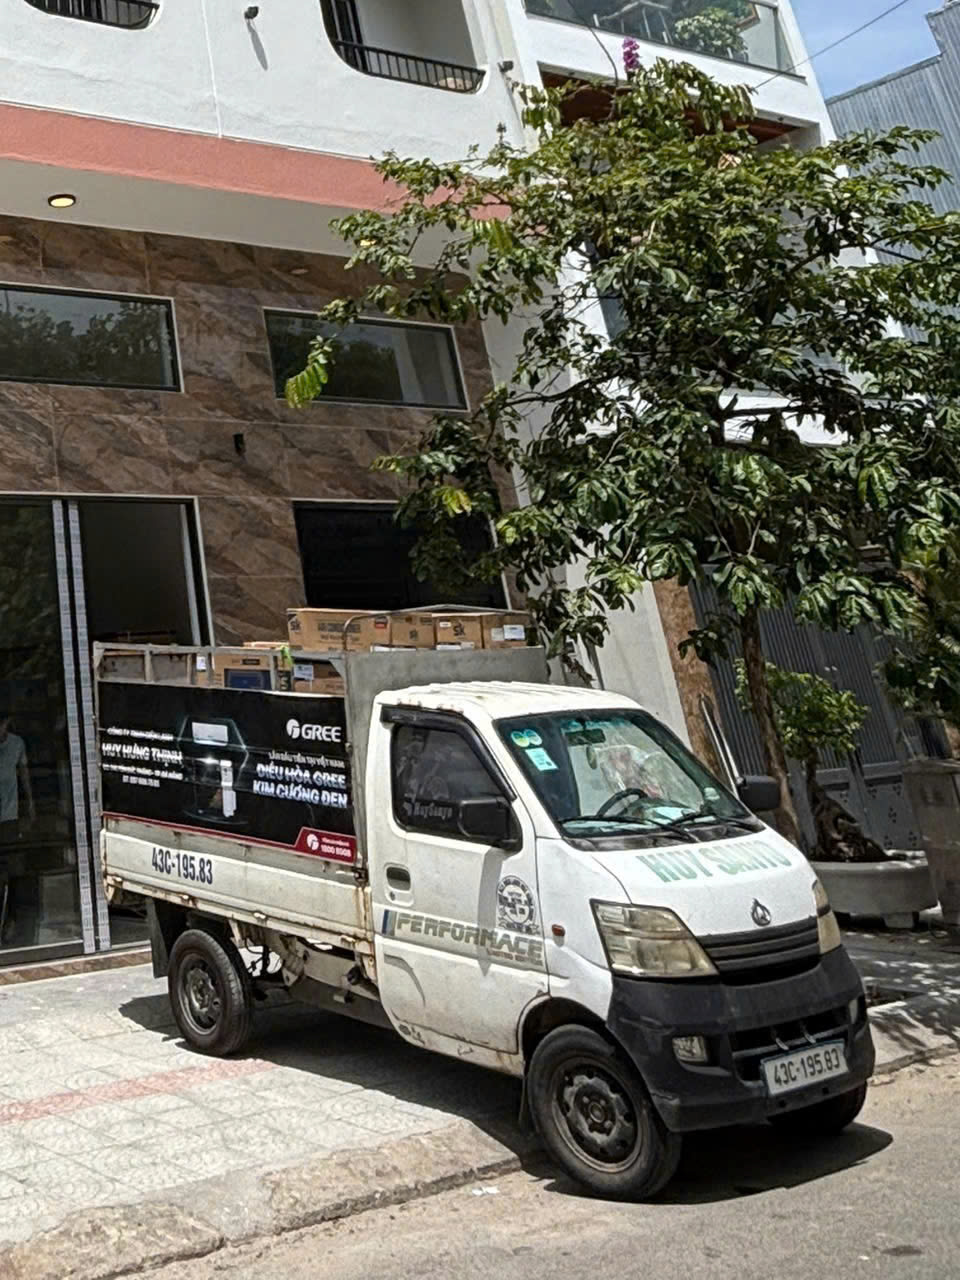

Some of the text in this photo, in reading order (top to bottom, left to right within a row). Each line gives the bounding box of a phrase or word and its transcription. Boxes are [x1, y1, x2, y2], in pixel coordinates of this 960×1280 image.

[301, 723, 342, 743] GREE
[253, 779, 275, 798] KIM
[320, 790, 348, 809] ĐEN
[284, 764, 313, 784] HÒA
[312, 770, 347, 790] GREE
[152, 847, 213, 885] 43C-195.83
[635, 849, 713, 883] HUY
[396, 913, 544, 959] PERFORMACE
[773, 1047, 841, 1086] 43C-195.83
